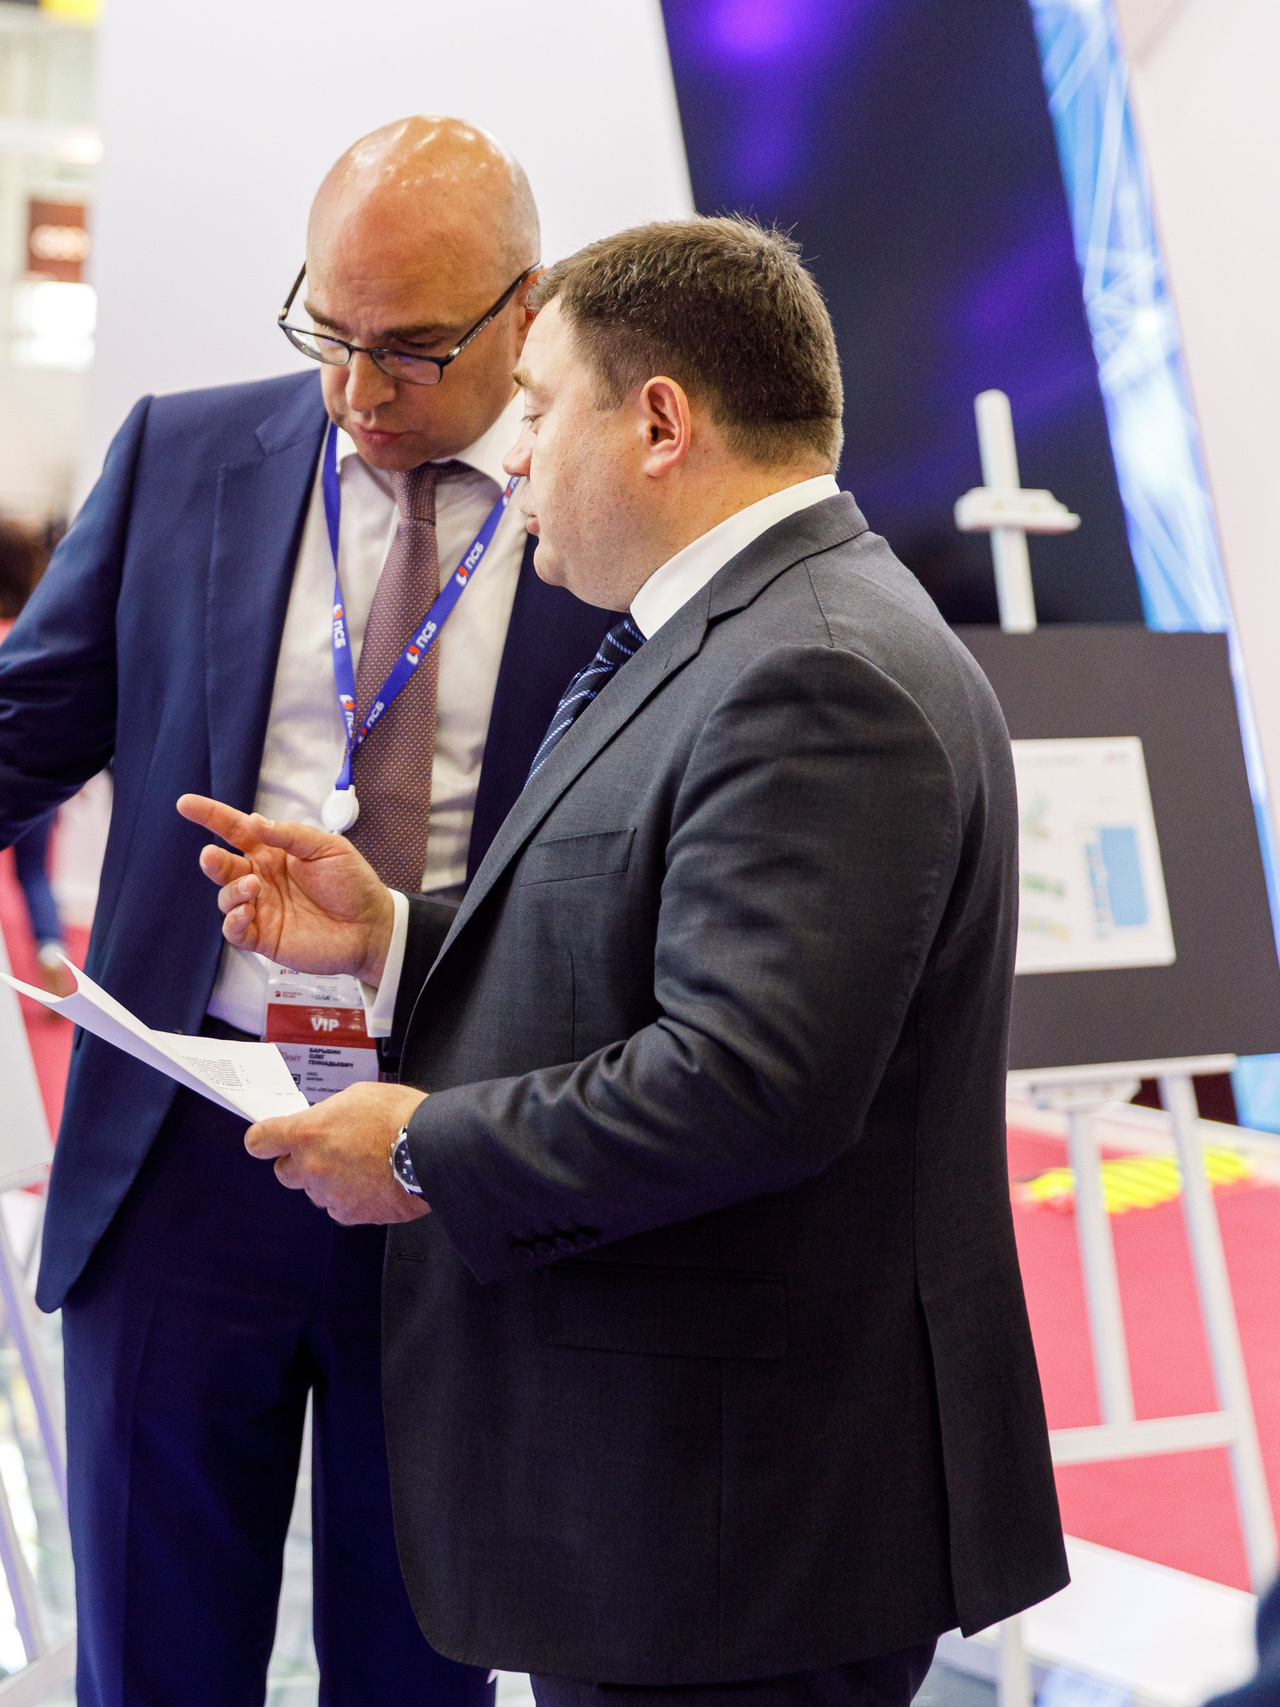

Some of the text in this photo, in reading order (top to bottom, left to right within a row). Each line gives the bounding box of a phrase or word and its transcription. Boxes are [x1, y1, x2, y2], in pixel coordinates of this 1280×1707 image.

[464, 541, 484, 570] ПСБ
[333, 619, 346, 649] ПСБ
[416, 620, 437, 649] ПСБ
[366, 700, 385, 728] ПСБ
[311, 1016, 340, 1031] VIP
